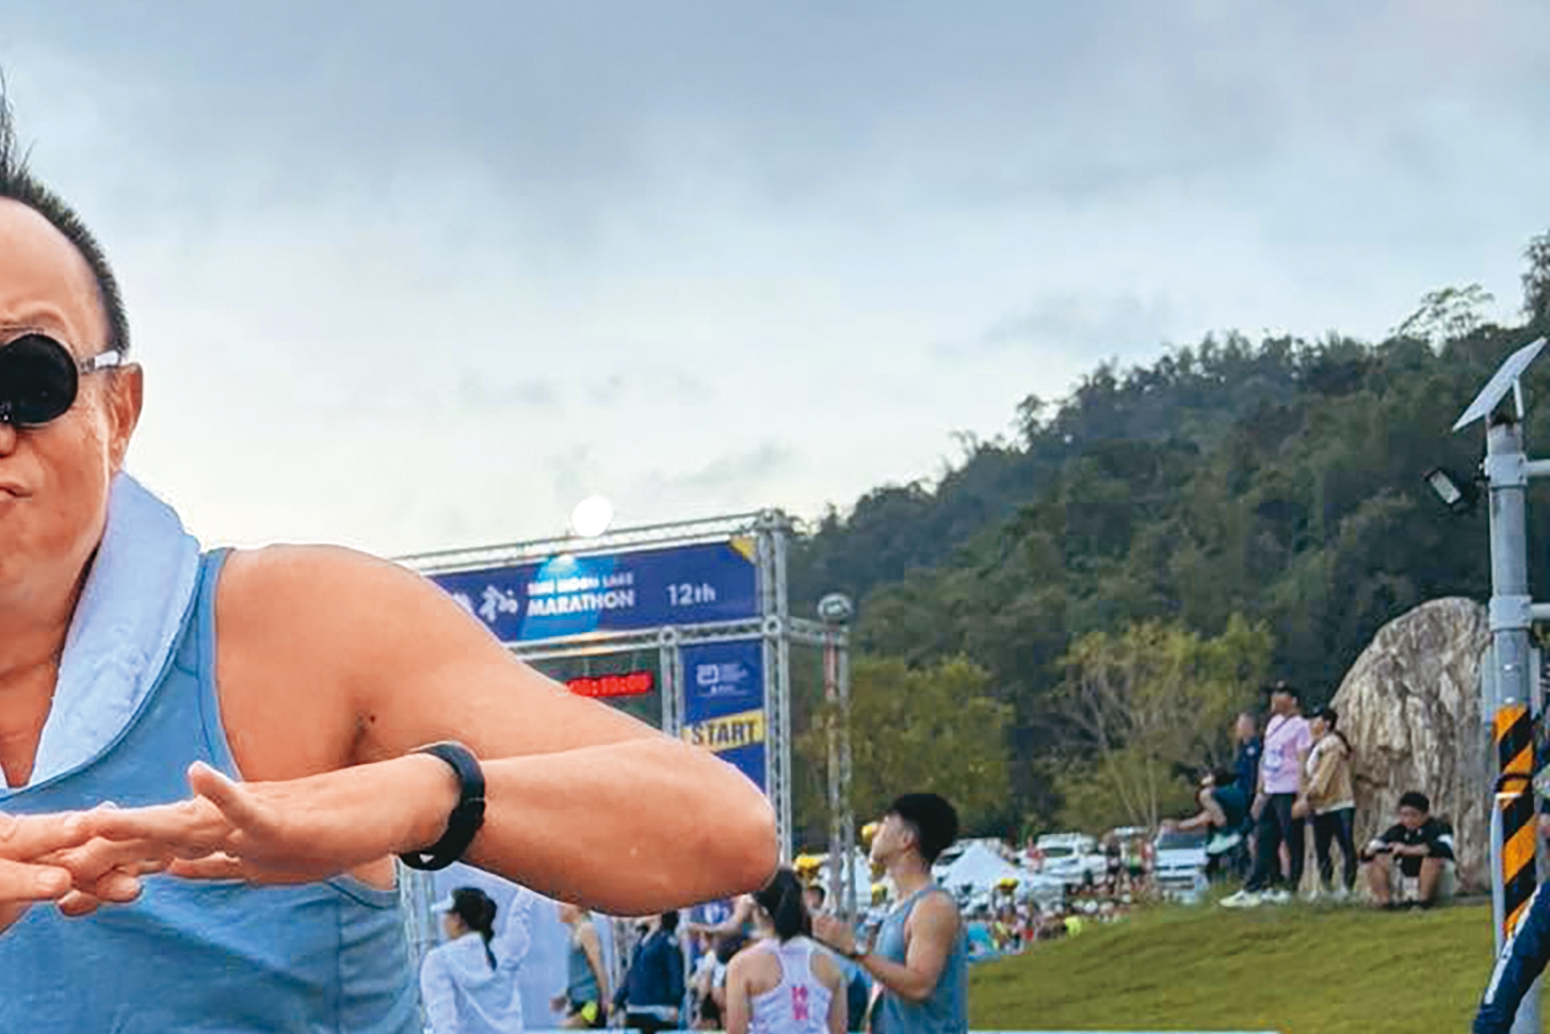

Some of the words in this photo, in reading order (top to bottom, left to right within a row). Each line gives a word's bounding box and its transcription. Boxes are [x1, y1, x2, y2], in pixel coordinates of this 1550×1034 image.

[526, 589, 635, 617] MARATHON
[667, 583, 717, 606] 12th
[691, 719, 758, 746] START
